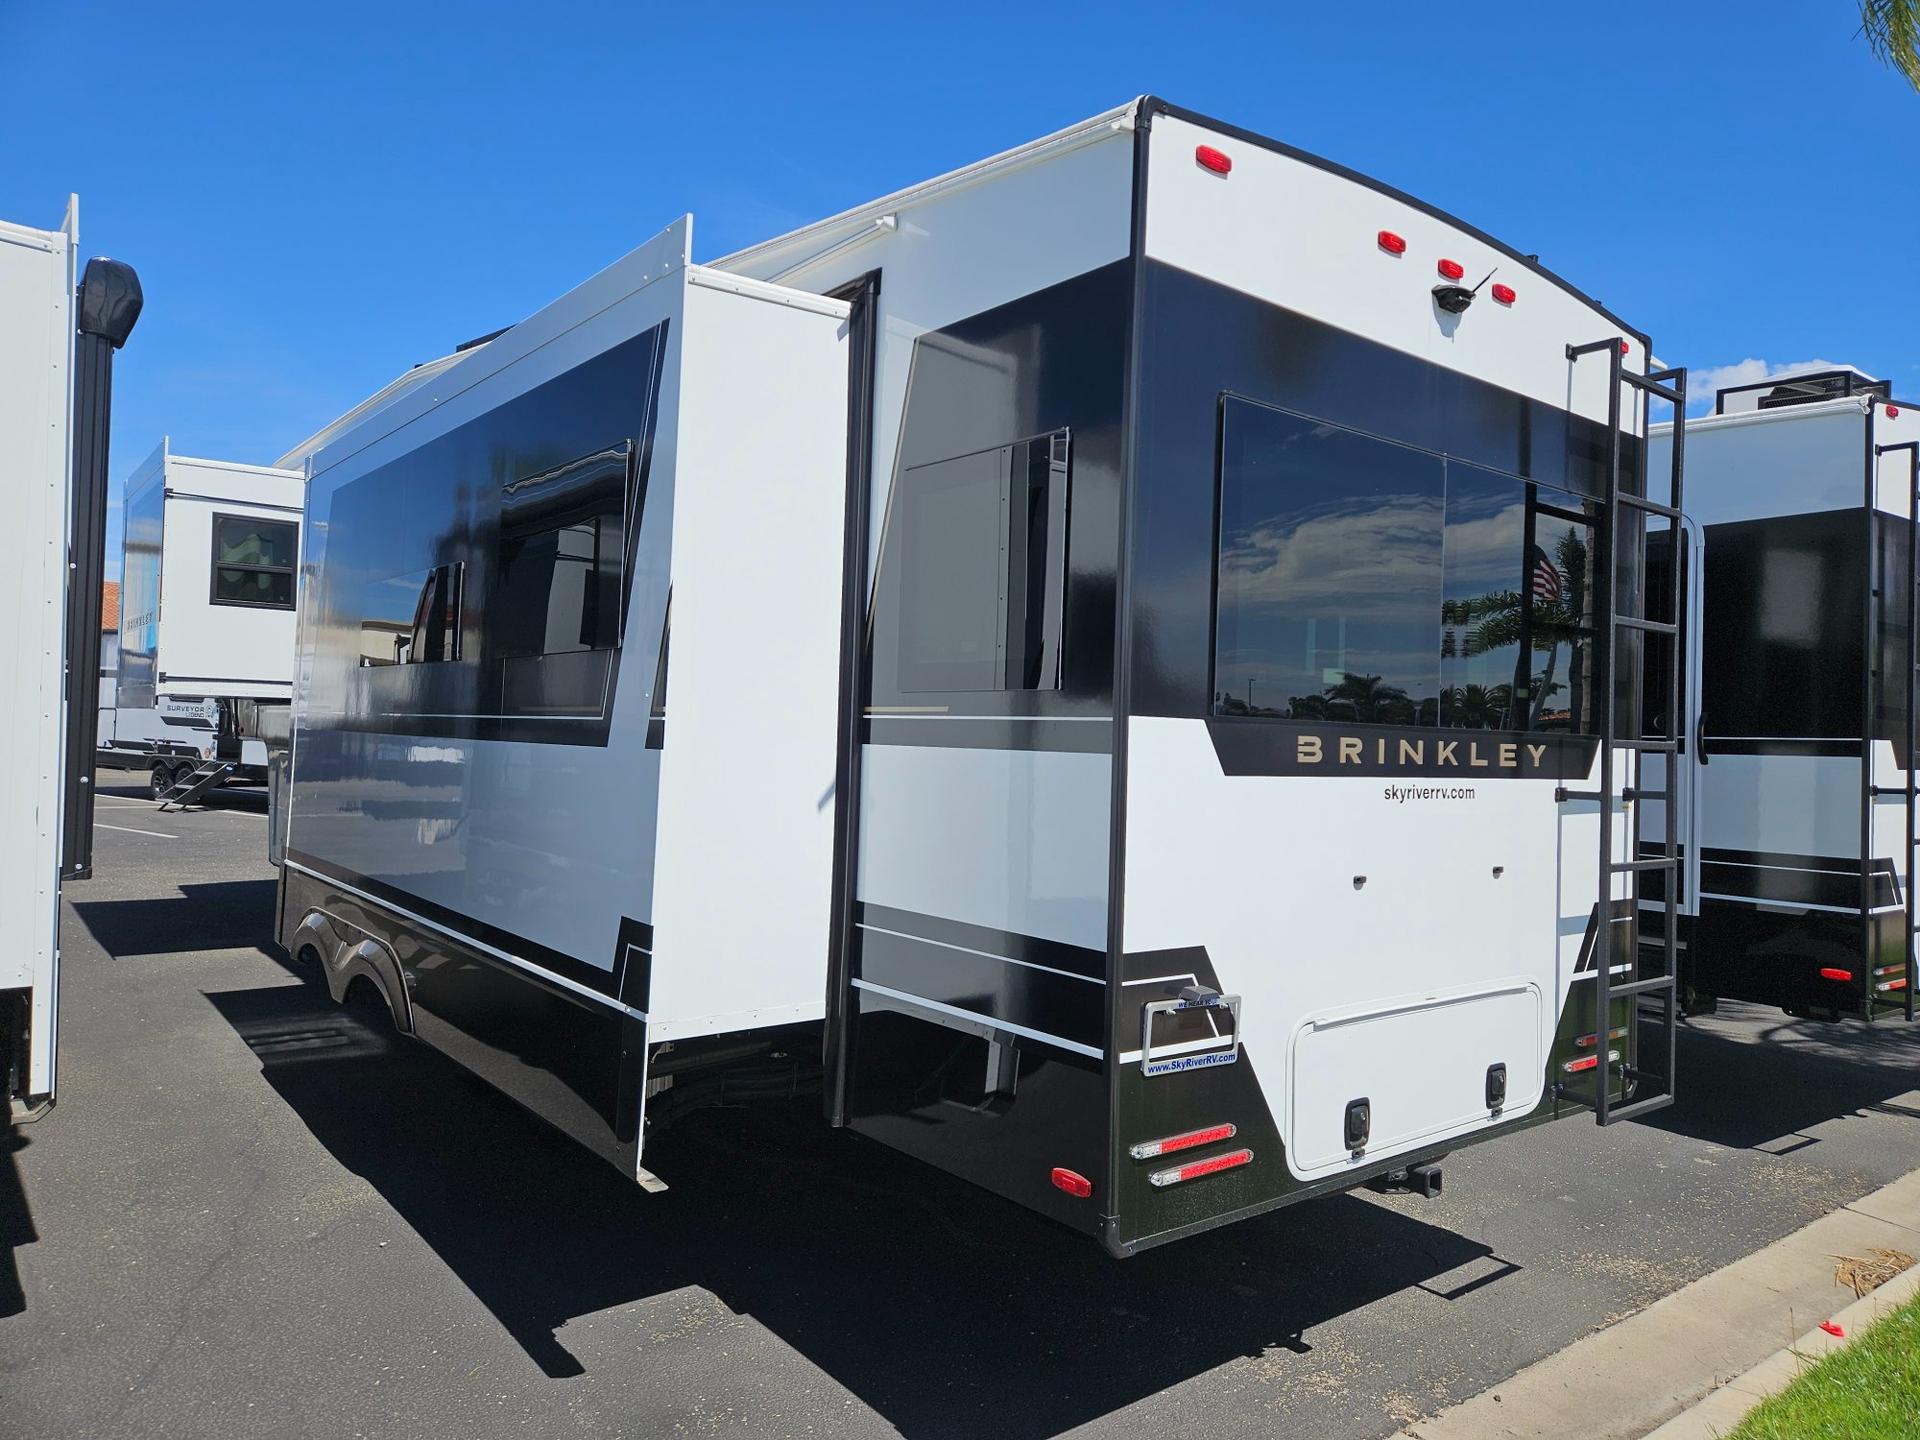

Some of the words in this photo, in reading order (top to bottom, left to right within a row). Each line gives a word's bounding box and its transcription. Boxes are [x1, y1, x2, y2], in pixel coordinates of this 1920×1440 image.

[1297, 735, 1546, 767] BRINKLEY
[1384, 784, 1475, 803] skyriverrv.com
[1148, 1054, 1235, 1074] www.SkyRiverRV.com
